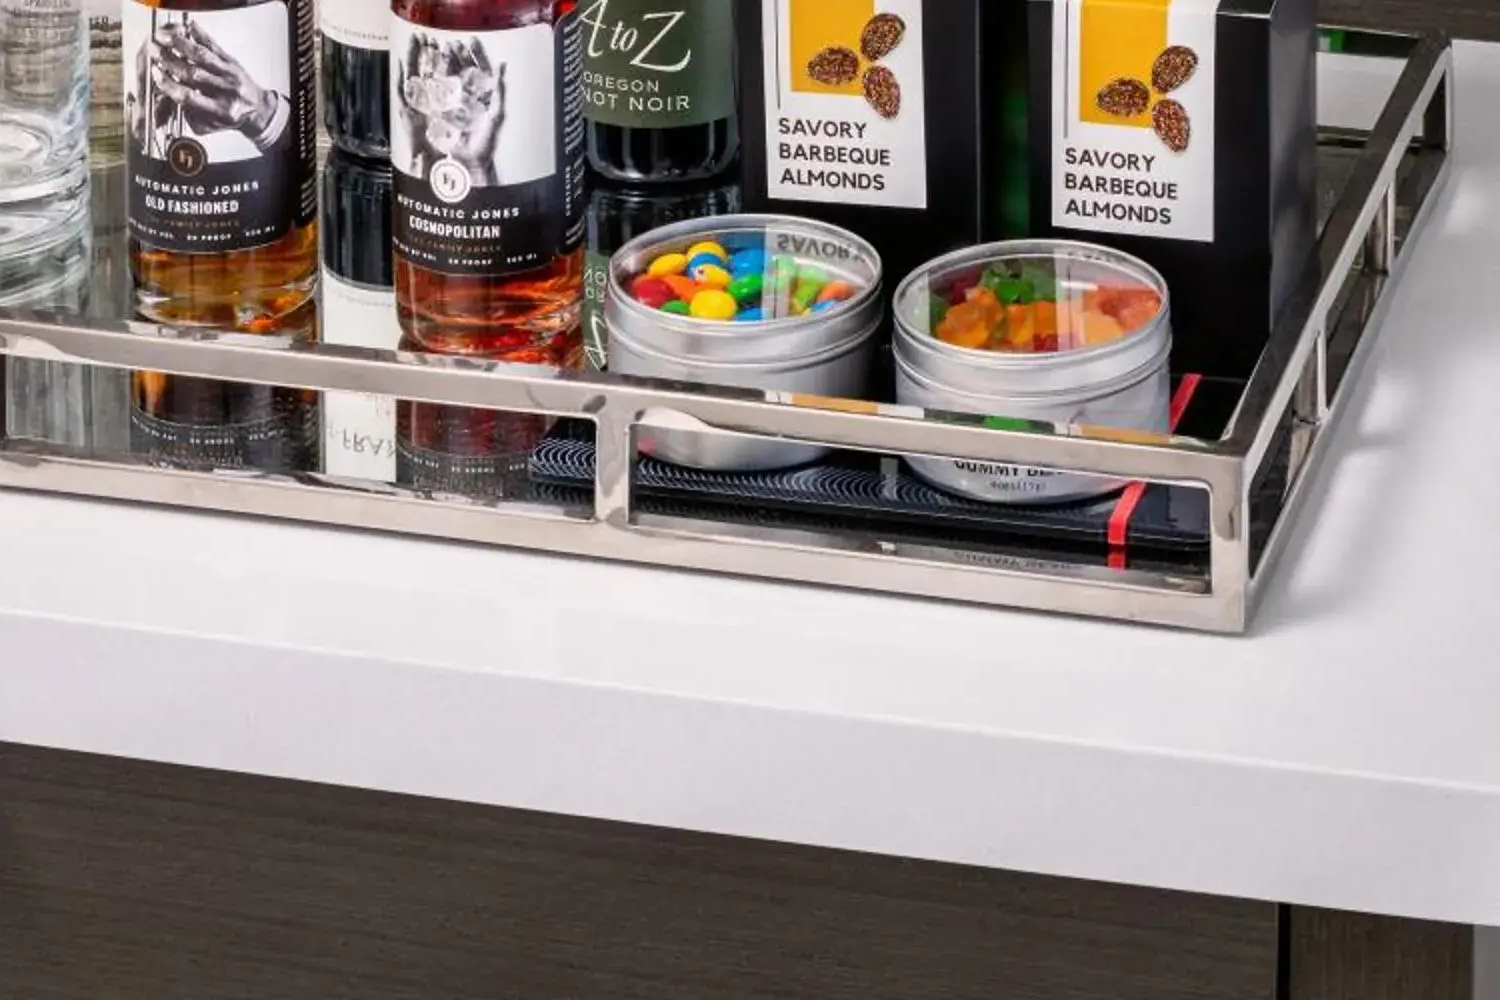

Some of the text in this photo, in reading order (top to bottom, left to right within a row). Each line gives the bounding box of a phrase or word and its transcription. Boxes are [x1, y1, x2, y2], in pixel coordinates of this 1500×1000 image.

[610, 20, 639, 52] to
[629, 10, 692, 73] Z
[583, 71, 659, 93] OREGON
[581, 85, 691, 112] NOT NOIR
[778, 116, 867, 138] SAVORY
[778, 143, 891, 167] BARBEQUE
[1065, 147, 1156, 172] SAVORY
[135, 174, 260, 196] AUTOMATIC JONES
[780, 167, 885, 191] ALMONDS
[1064, 173, 1178, 200] BARBEQUE
[144, 194, 240, 216] OLD FASHIONED
[397, 193, 520, 220] AUTOMATIC JONES
[1064, 199, 1173, 225] ALMONDS
[409, 215, 501, 239] COSMOPOLITAN
